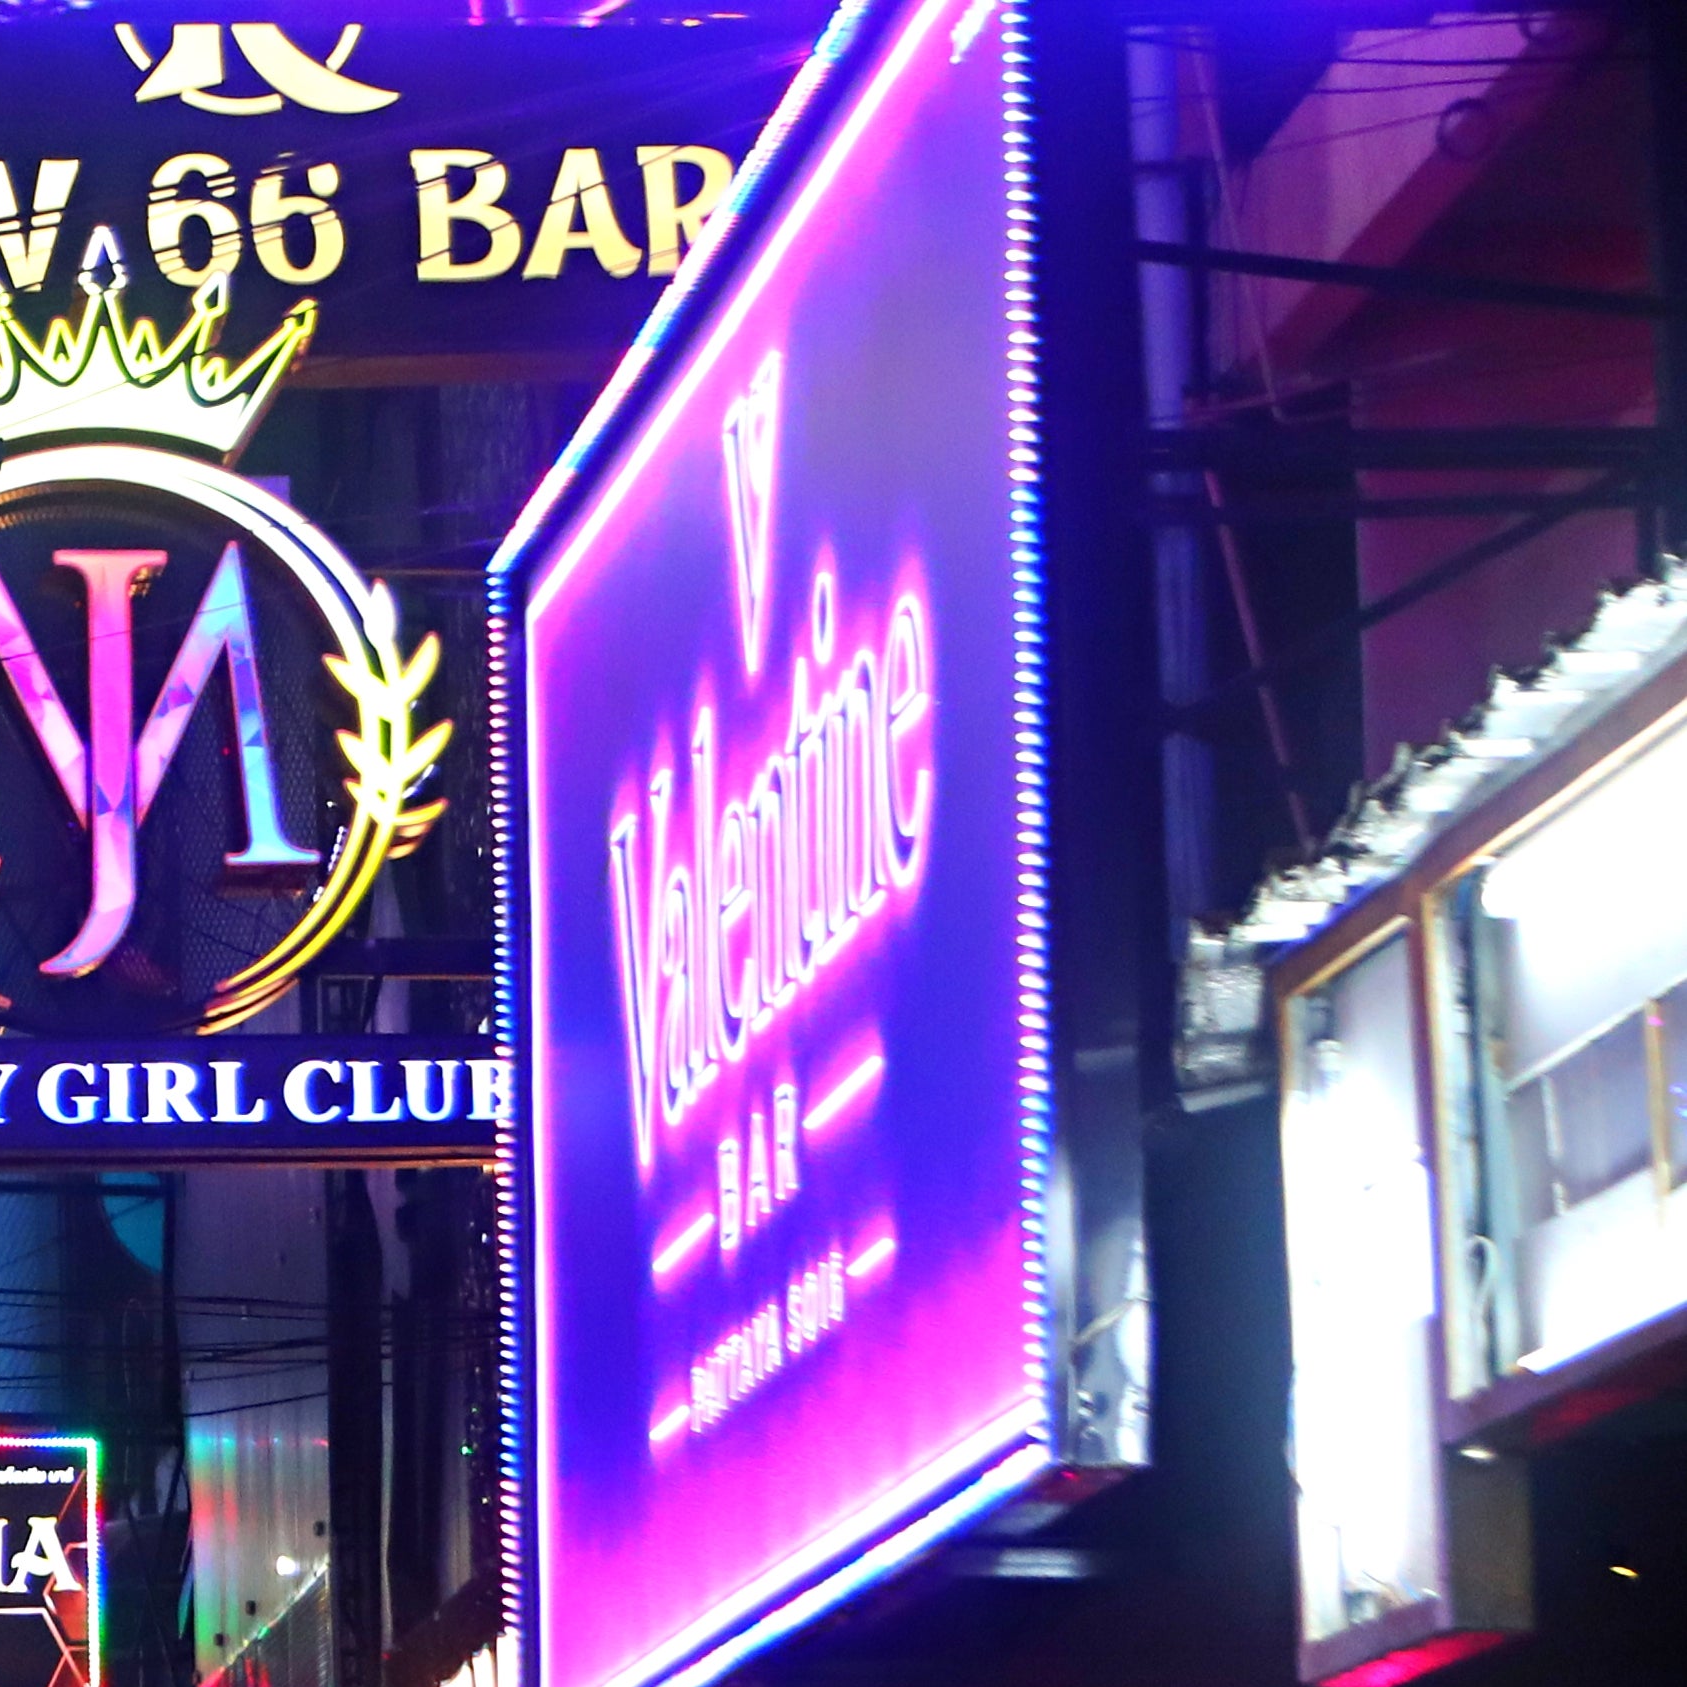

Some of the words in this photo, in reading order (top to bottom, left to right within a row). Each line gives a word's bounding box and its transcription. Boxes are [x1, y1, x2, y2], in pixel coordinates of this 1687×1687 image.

[147, 150, 346, 290] 66
[408, 144, 739, 282] BAR
[610, 570, 930, 1167] Valentine
[37, 1061, 267, 1126] GIRL
[284, 1058, 511, 1123] CLUB
[718, 1083, 800, 1251] BAR
